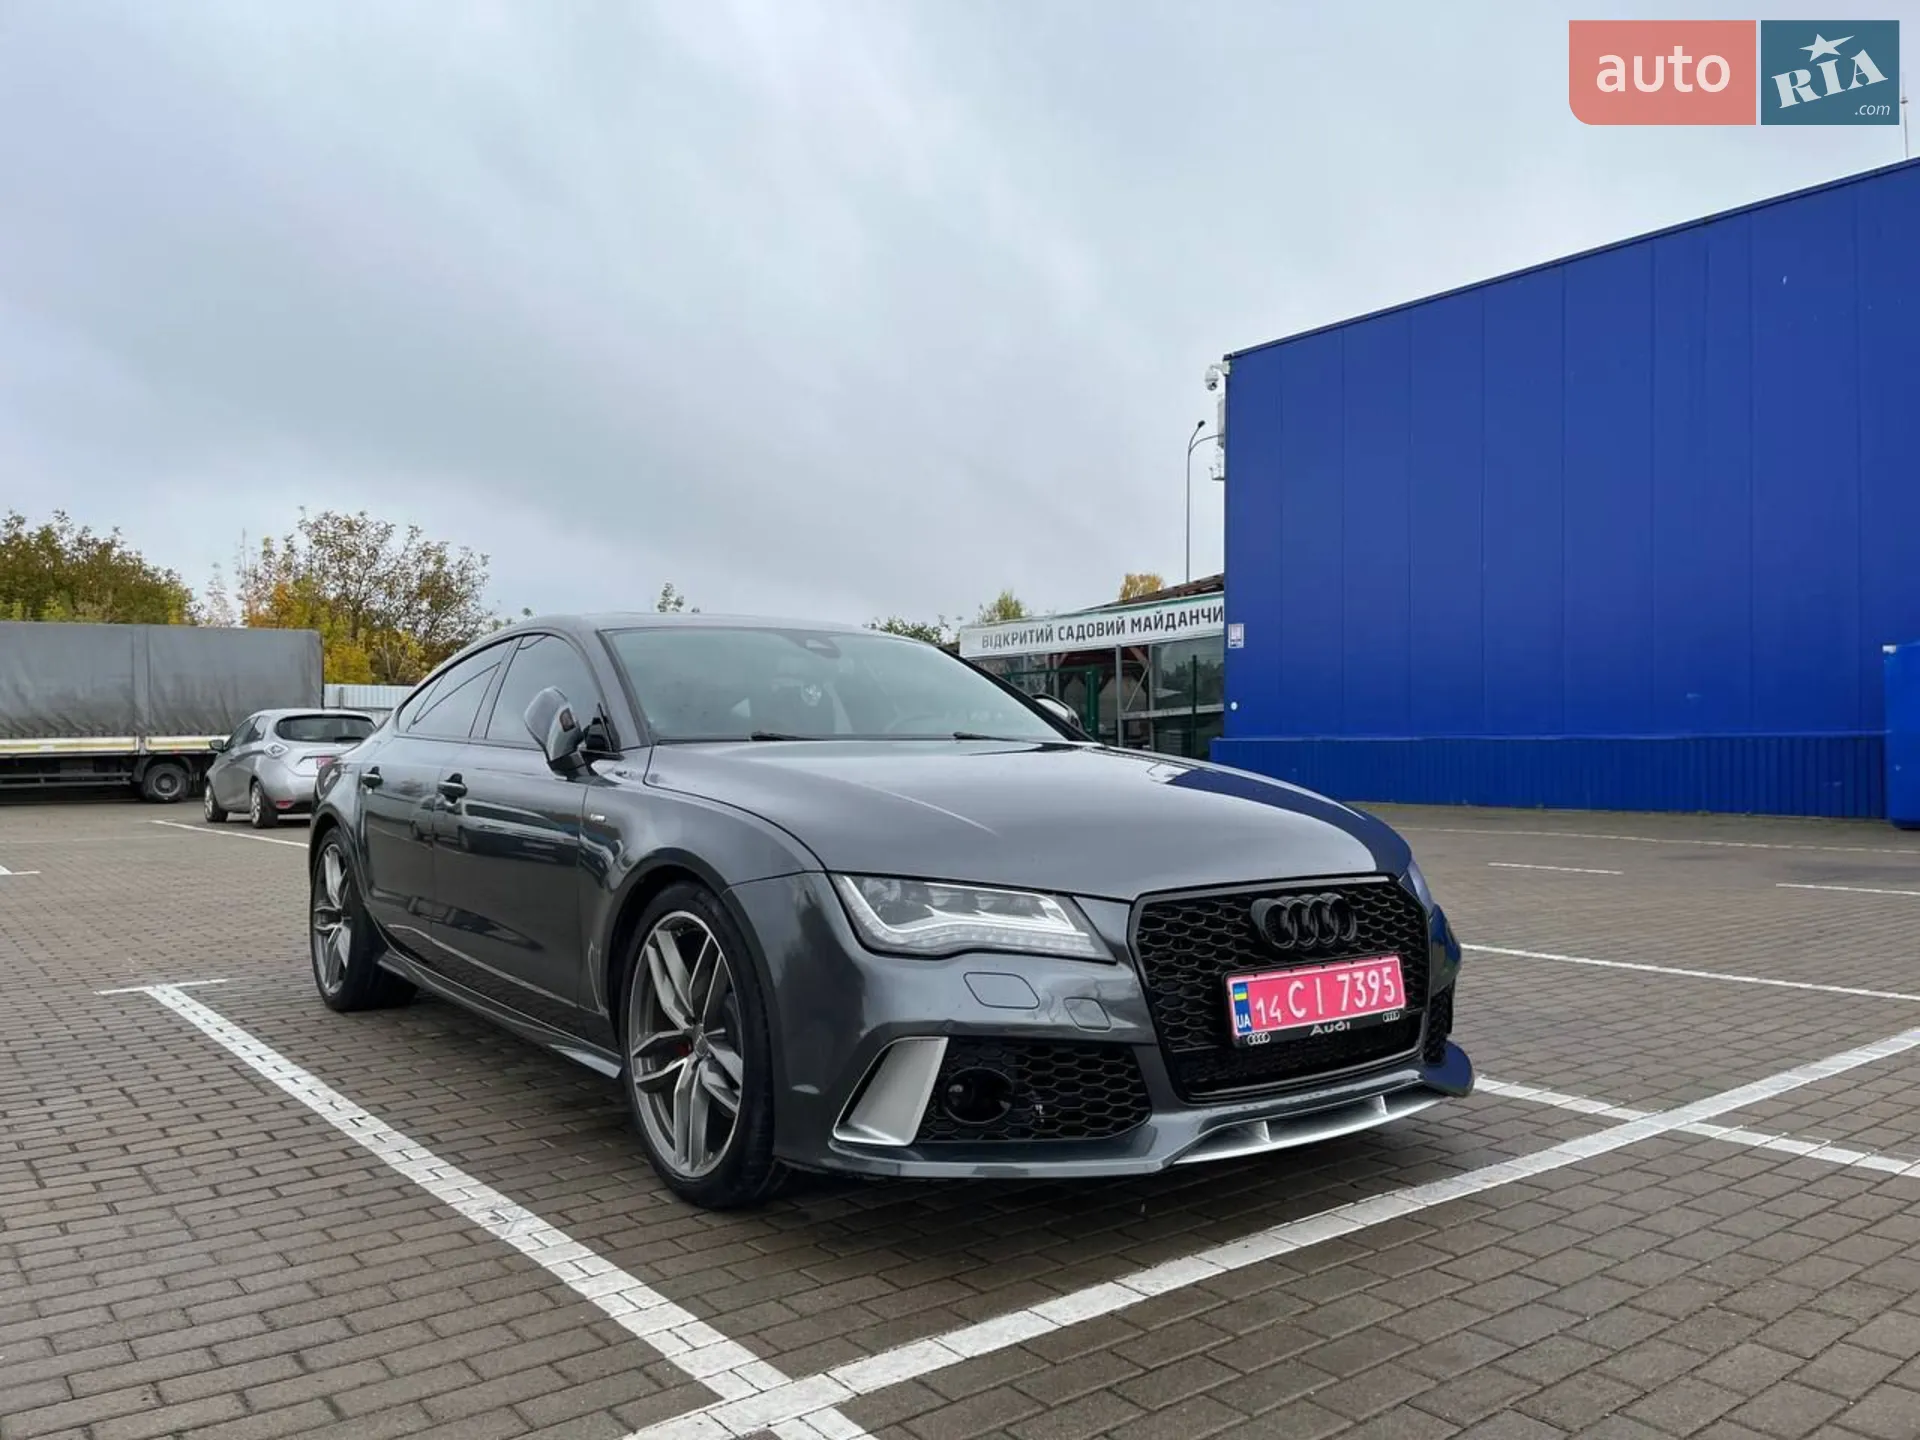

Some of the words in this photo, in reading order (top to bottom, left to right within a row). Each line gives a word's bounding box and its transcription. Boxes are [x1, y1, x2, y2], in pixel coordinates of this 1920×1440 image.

[981, 626, 1054, 649] ВІДКРИТИЙ
[1058, 623, 1126, 641] САДОВИЙ
[1237, 1014, 1251, 1028] UA
[1337, 967, 1395, 1011] 7395
